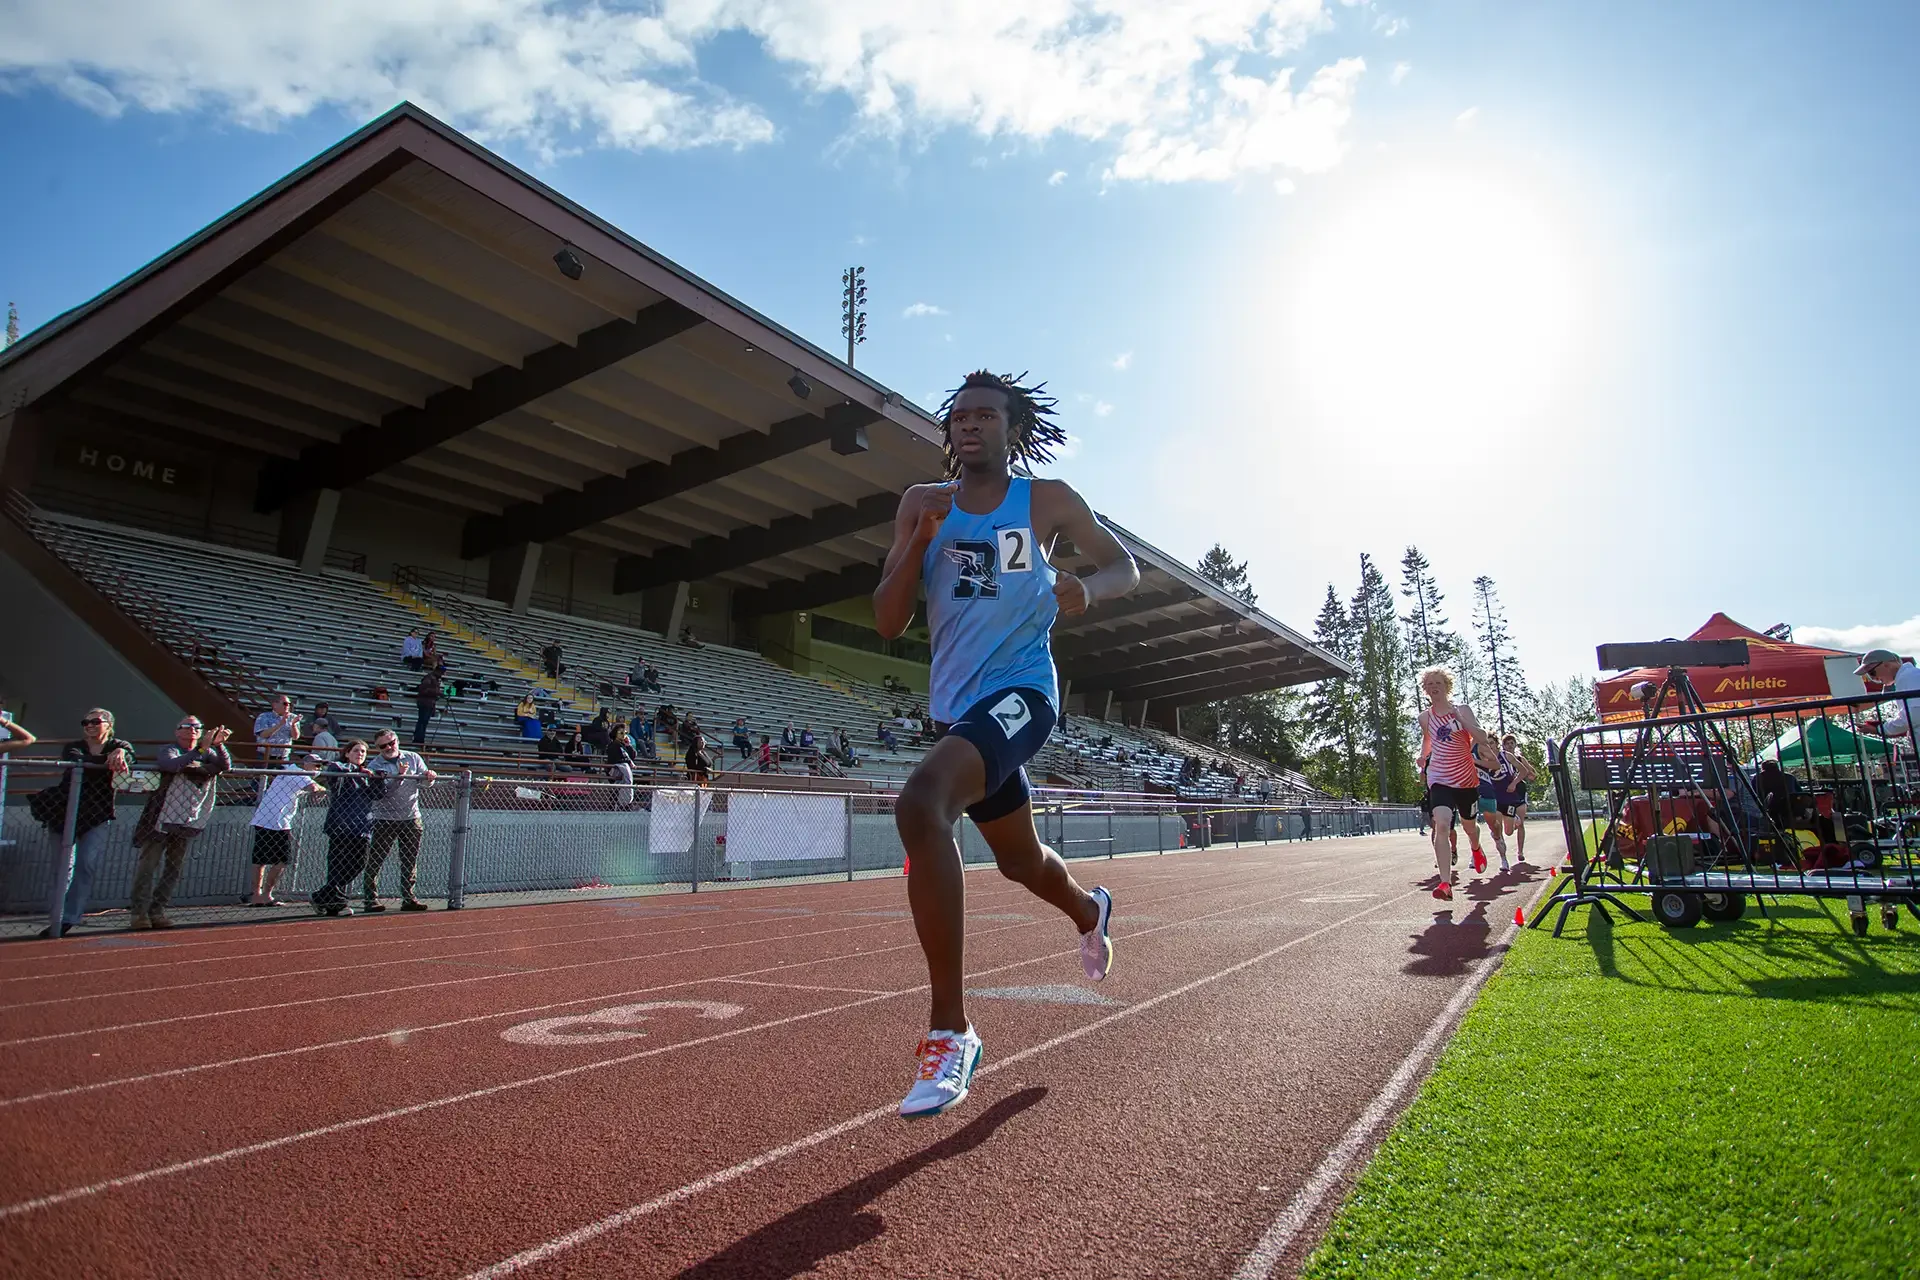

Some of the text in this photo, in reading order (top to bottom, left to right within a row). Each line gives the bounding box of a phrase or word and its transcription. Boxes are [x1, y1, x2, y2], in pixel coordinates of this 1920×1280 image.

[79, 446, 176, 485] HOME
[952, 539, 999, 600] R
[1005, 531, 1026, 570] 2
[1713, 675, 1788, 694] Athletic
[995, 699, 1026, 732] 2
